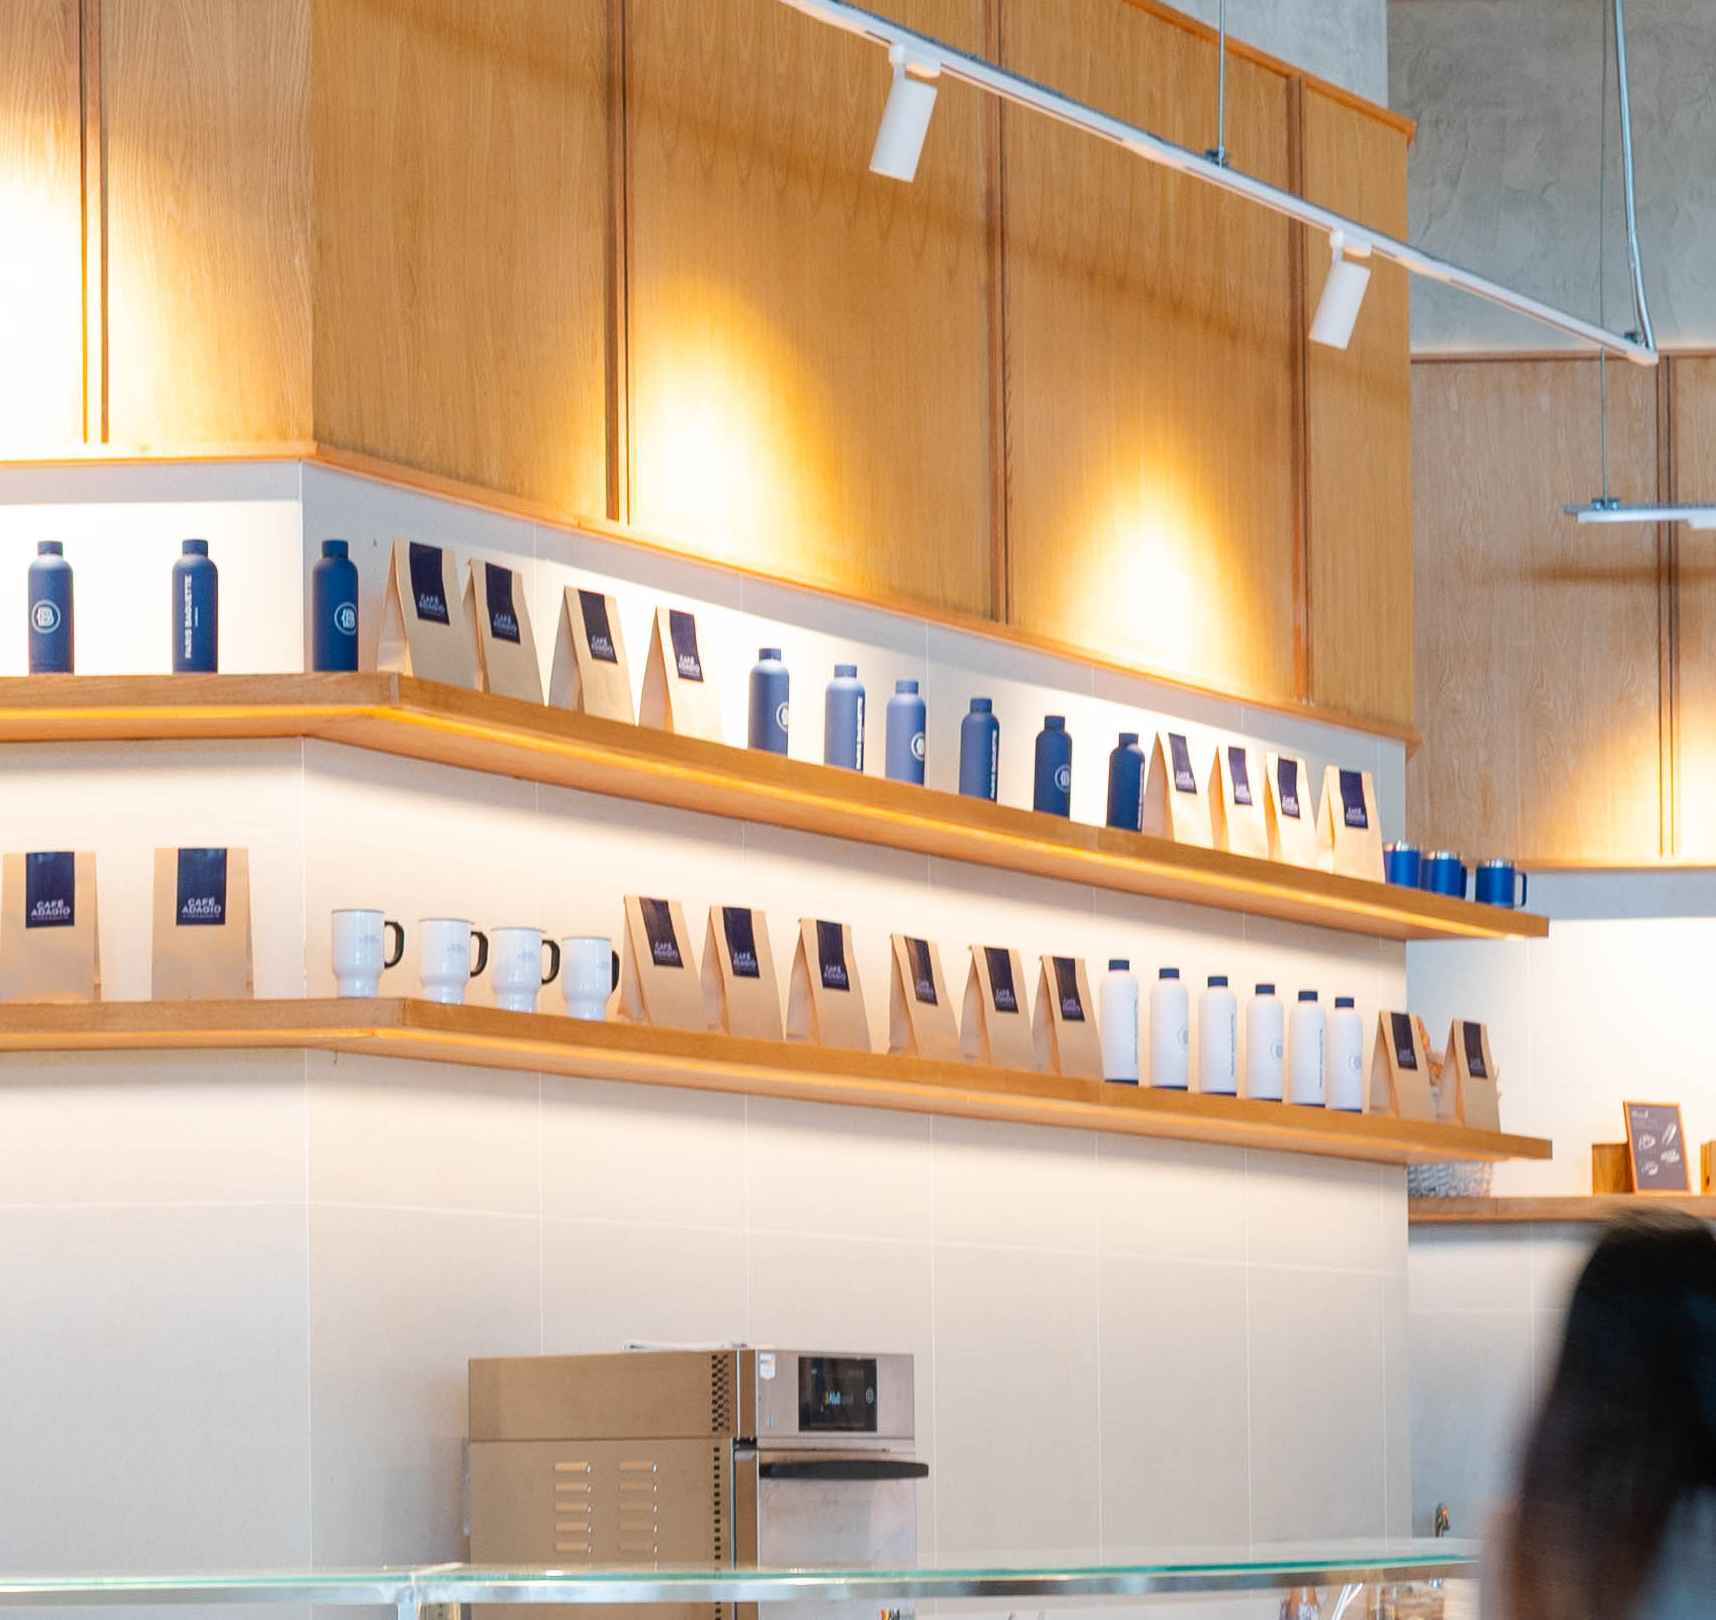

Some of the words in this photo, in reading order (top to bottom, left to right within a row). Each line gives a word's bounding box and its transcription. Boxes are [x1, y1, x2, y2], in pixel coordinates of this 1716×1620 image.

[36, 900, 64, 909] CAFÉ
[188, 897, 215, 906] CAFÉ
[31, 907, 70, 916] ADAGIO
[182, 905, 221, 914] ADAGIO
